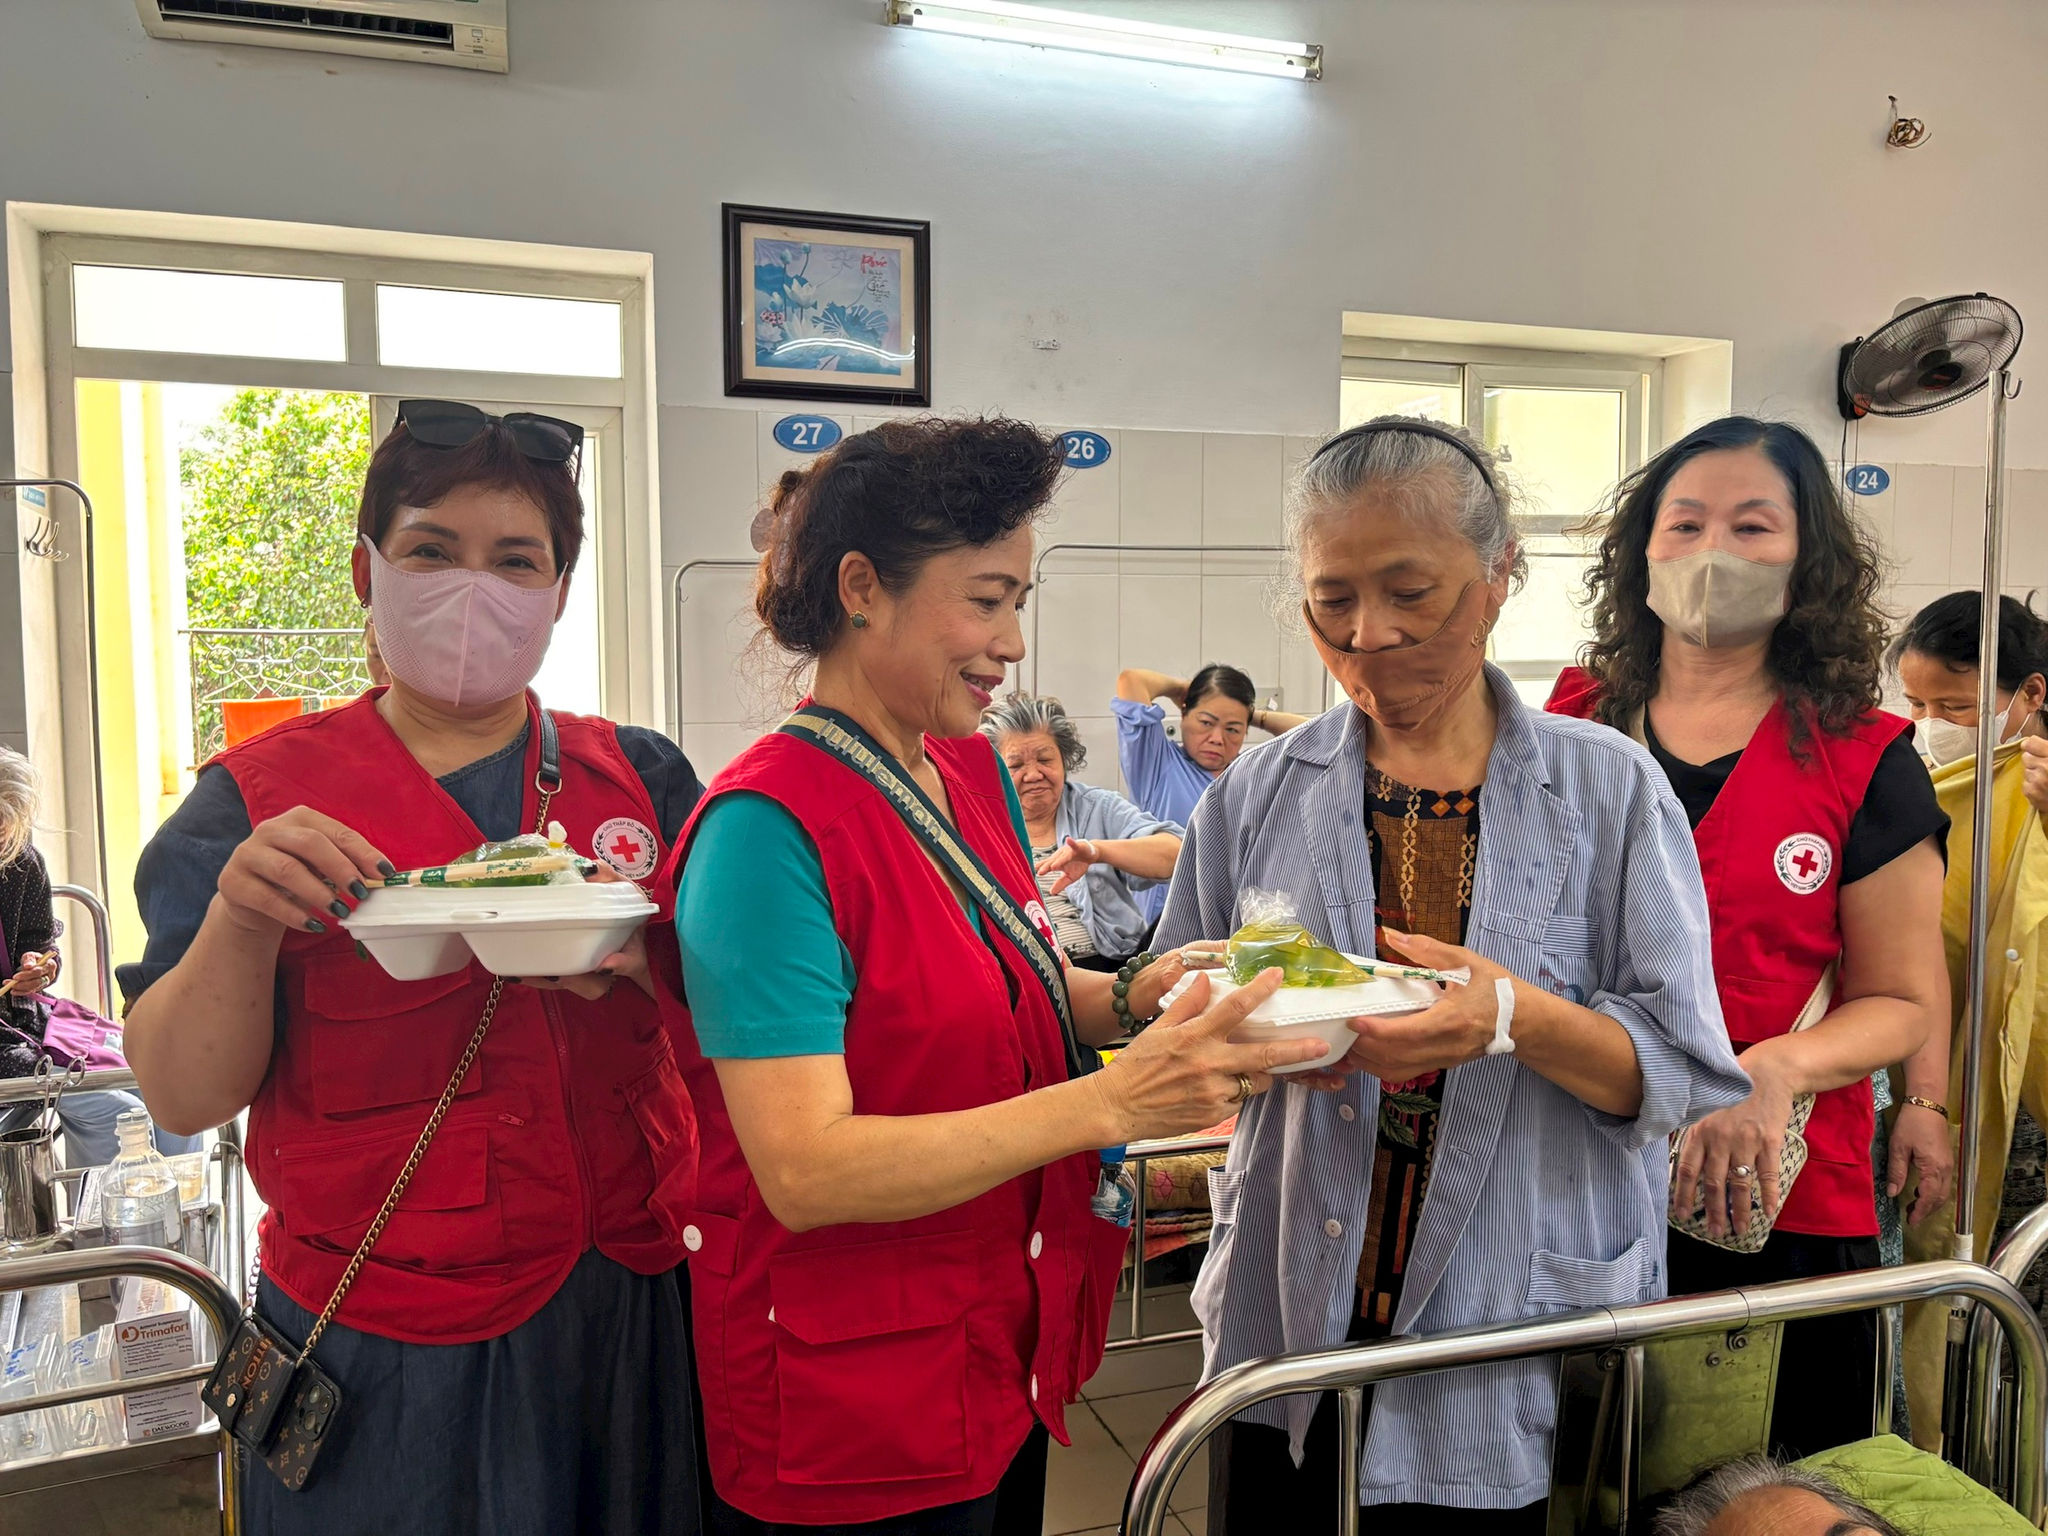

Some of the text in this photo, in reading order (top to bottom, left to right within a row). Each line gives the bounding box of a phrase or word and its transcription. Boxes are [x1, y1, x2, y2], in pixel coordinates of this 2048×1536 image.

[792, 422, 823, 445] 27
[1067, 437, 1096, 460] 26
[1858, 471, 1878, 488] 24
[141, 1322, 189, 1340] Trimafort
